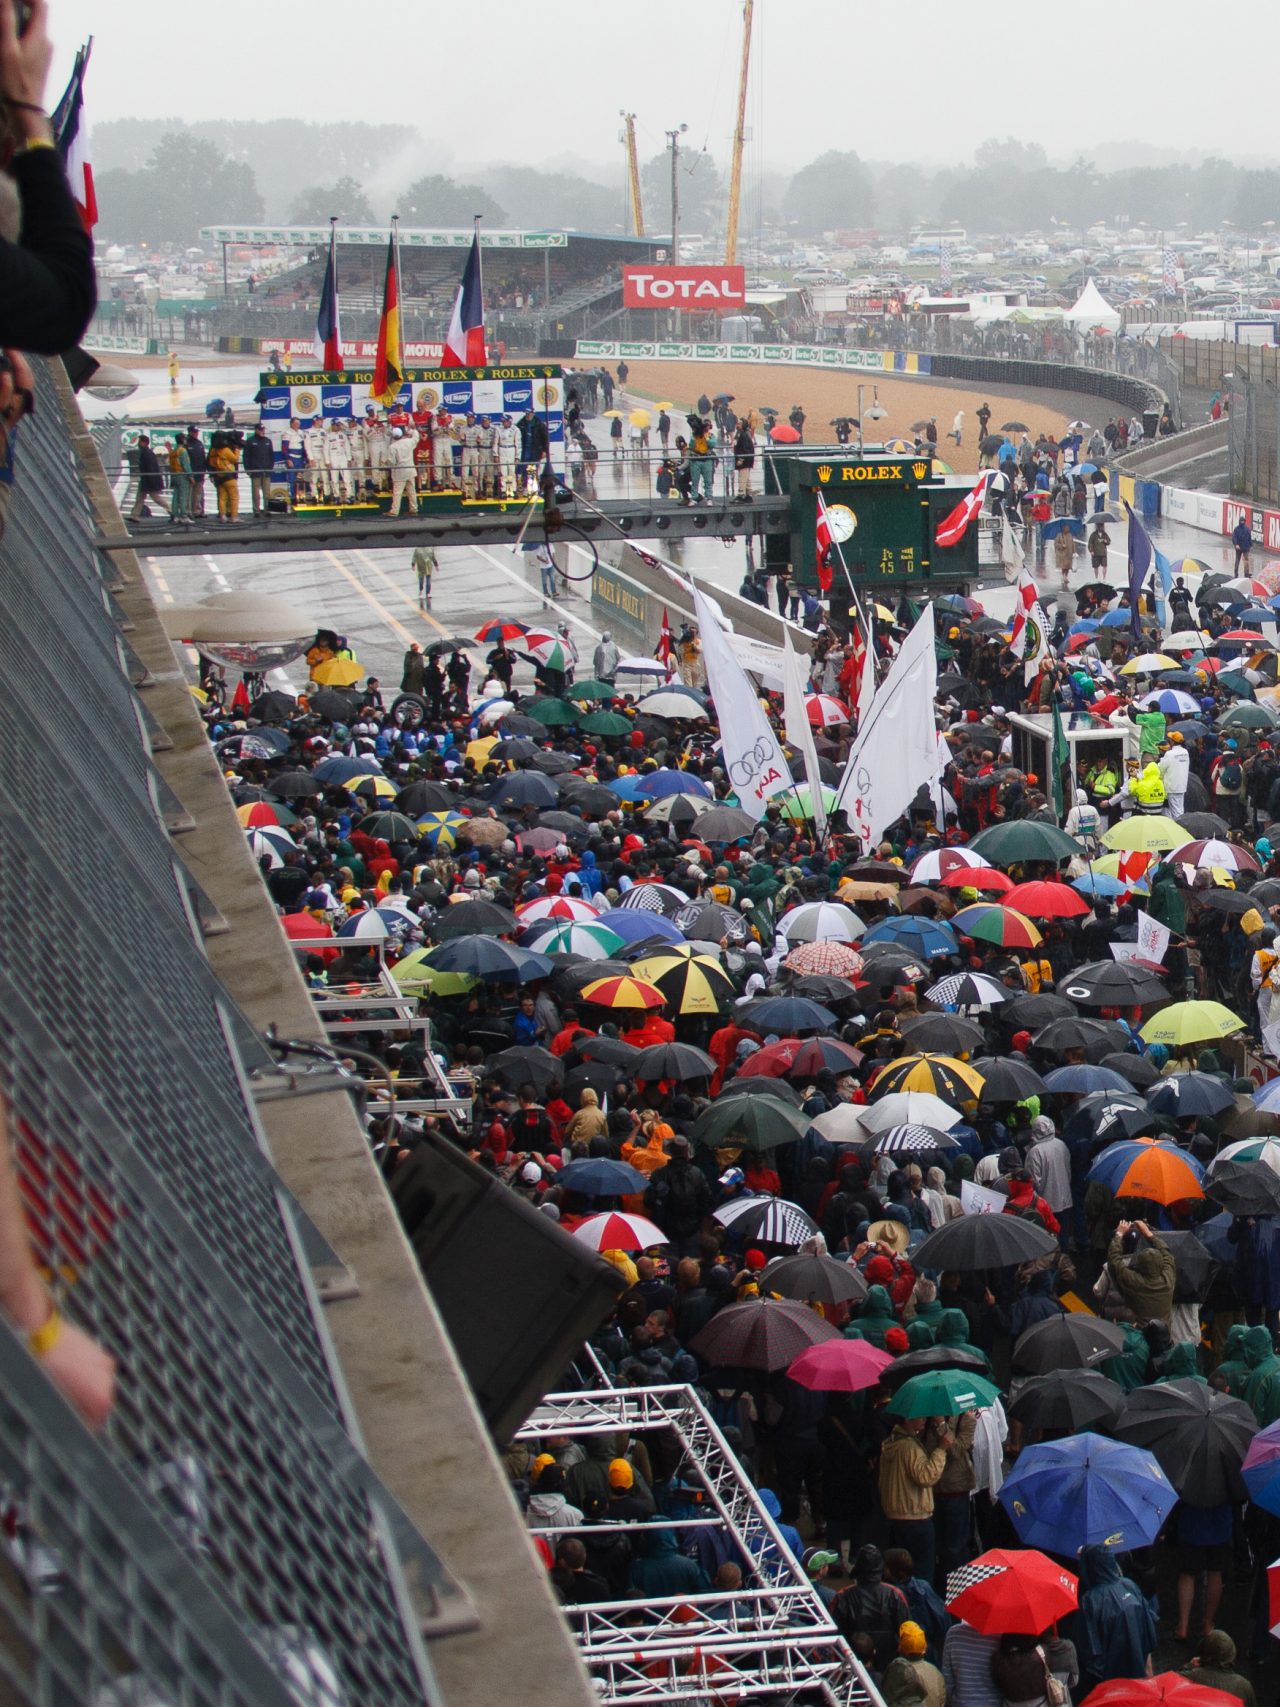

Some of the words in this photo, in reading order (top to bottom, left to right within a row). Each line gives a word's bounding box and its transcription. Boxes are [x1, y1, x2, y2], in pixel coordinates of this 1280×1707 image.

[628, 274, 742, 298] TOTAL
[290, 342, 314, 354] MOTU
[404, 343, 443, 357] MOTUL
[285, 374, 330, 385] ROLEX
[423, 370, 468, 381] ROLEX
[491, 368, 537, 379] ROLEX
[841, 466, 902, 482] ROLEX
[880, 561, 895, 574] 15
[907, 560, 914, 573] 0
[931, 947, 950, 955] MARSH
